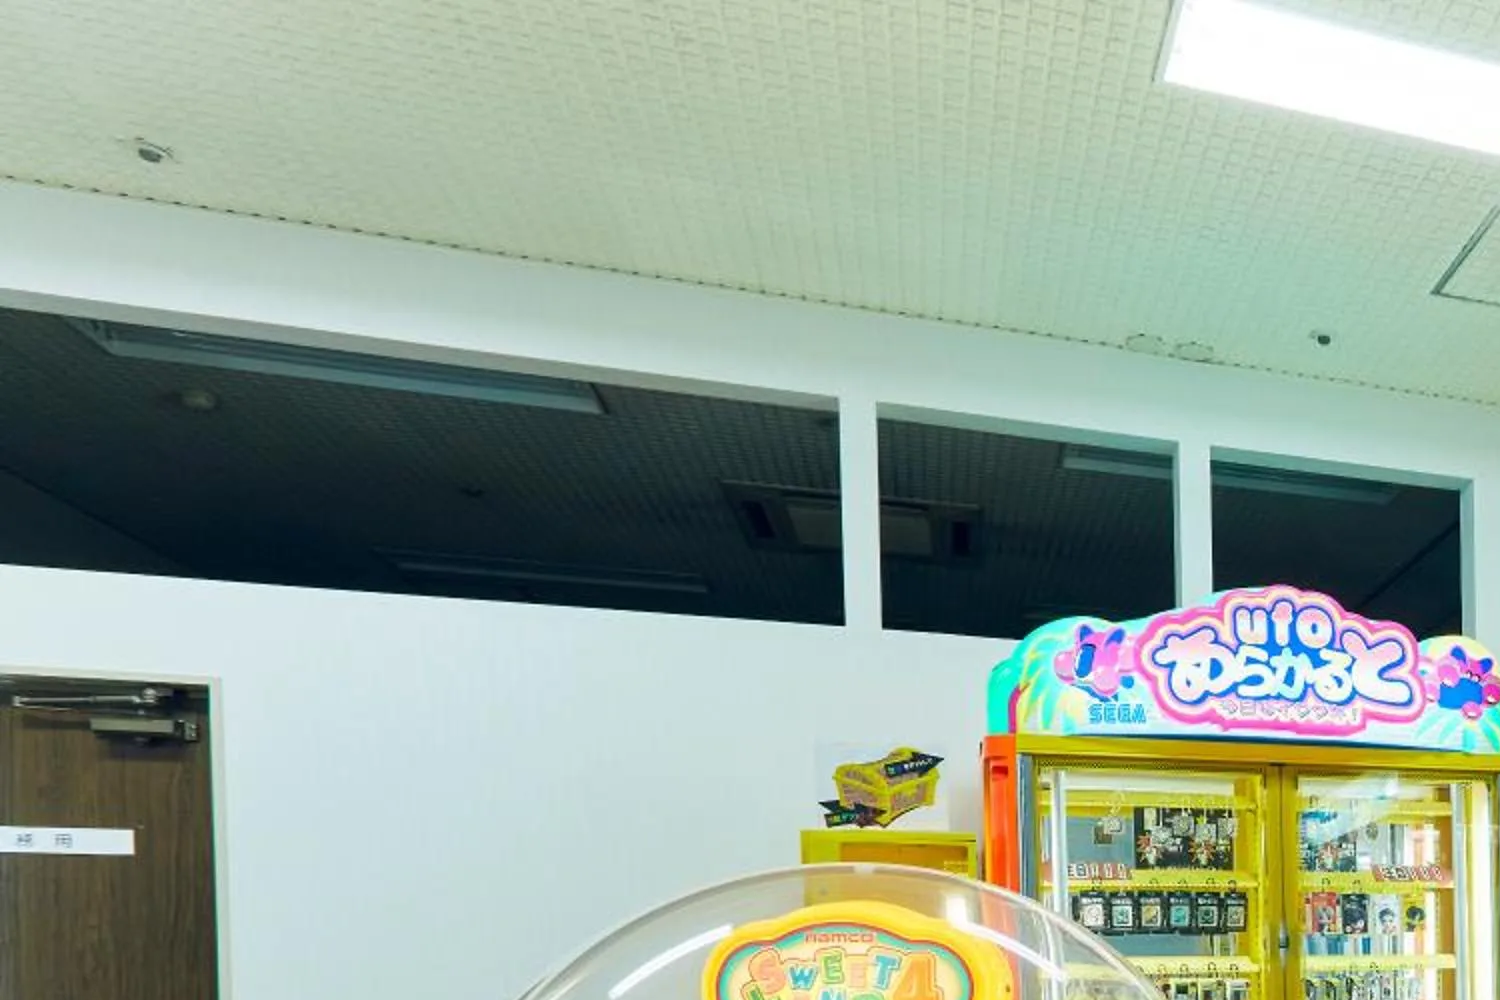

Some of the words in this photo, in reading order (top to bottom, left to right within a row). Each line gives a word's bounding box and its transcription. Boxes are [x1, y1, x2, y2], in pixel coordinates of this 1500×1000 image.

[1153, 625, 1414, 704] あらかると
[1087, 703, 1148, 725] SEGA
[803, 931, 876, 944] namco
[748, 950, 901, 994] SWEET
